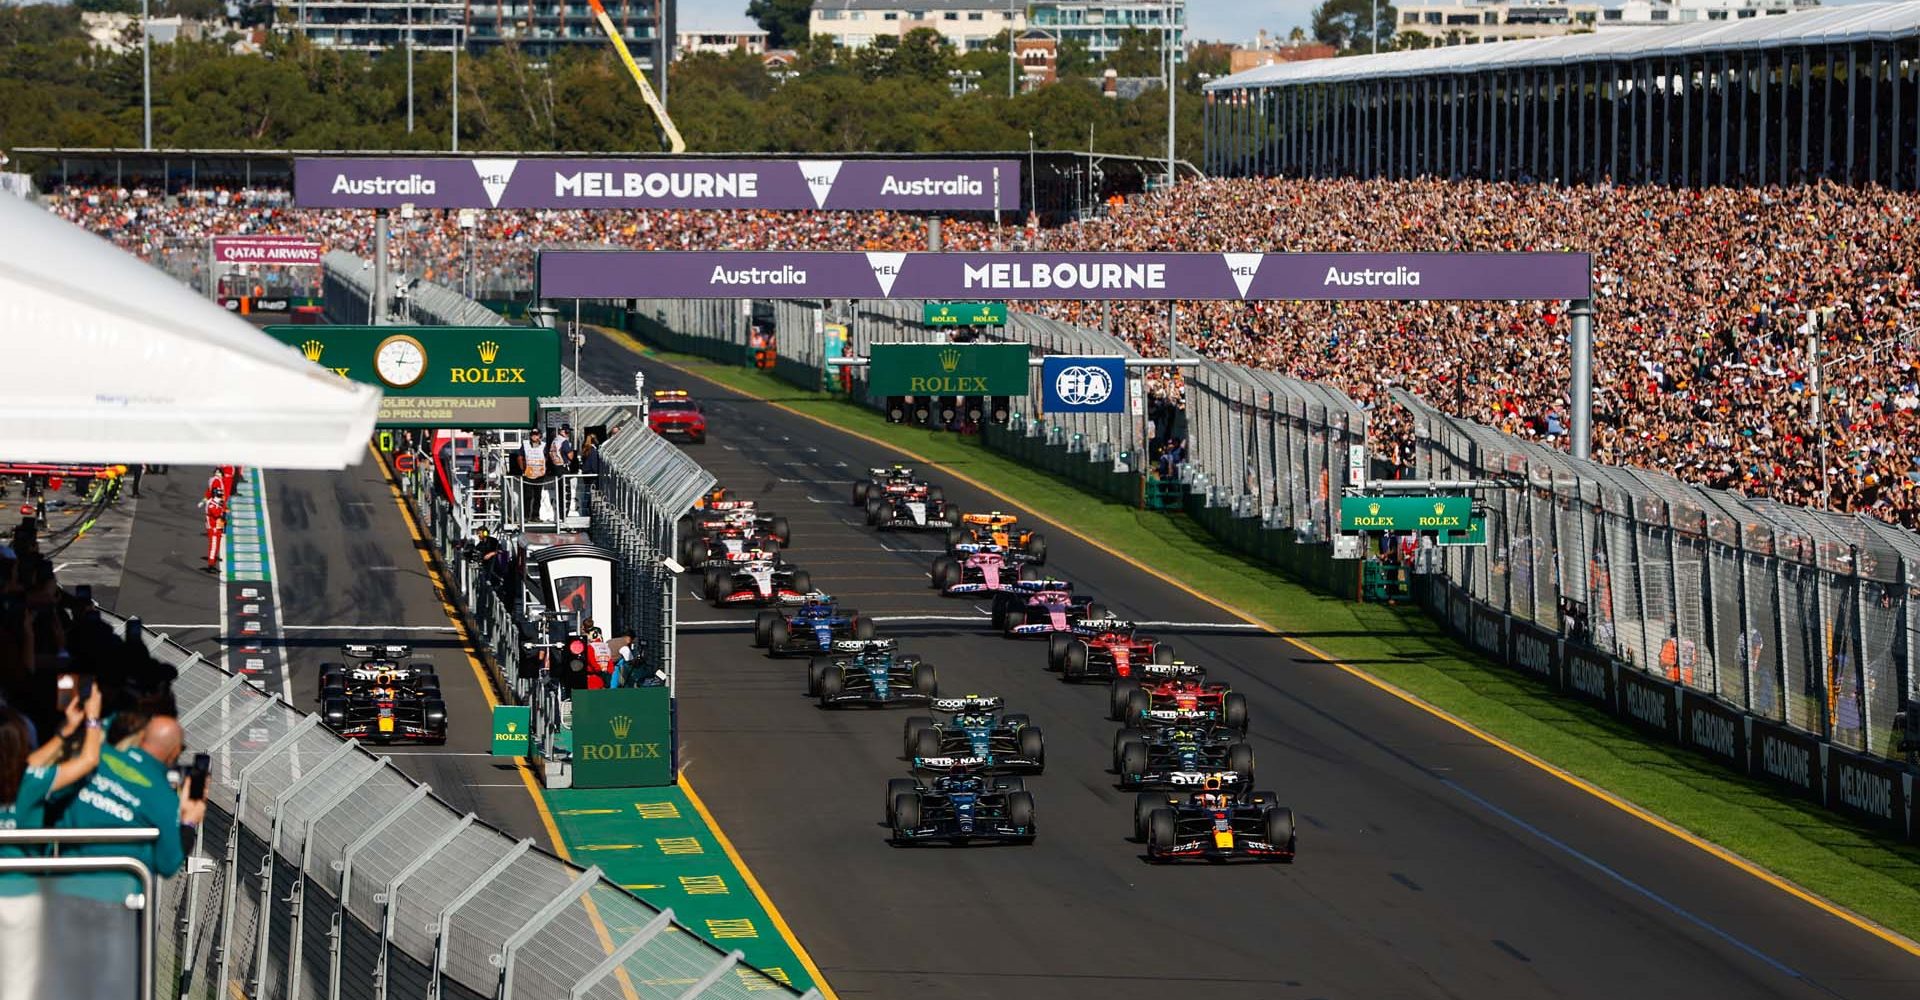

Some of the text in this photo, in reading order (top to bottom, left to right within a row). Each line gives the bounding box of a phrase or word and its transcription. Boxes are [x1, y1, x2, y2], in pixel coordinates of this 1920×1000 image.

[331, 174, 436, 195] Australia
[555, 171, 758, 198] MELBOURNE
[880, 175, 983, 195] Australia
[224, 247, 318, 259] QATAR AIRWAYS
[710, 265, 807, 285] Australia
[964, 262, 1166, 289] MELBOURNE
[1324, 266, 1420, 286] Australia
[450, 368, 526, 383] ROLEX
[911, 377, 989, 392] ROLEX
[417, 398, 496, 408] AUSTRALIAN
[393, 409, 421, 418] PRIX
[1354, 517, 1394, 526] ROLEX
[1419, 516, 1459, 526] ROLEX
[1626, 683, 1667, 729] MELBOURNE
[495, 733, 528, 741] ROLEX
[1691, 709, 1735, 758] MELBOURNE
[582, 743, 661, 760] ROLEX
[1763, 733, 1810, 788] MELBOURNE
[1839, 764, 1892, 819] MELBOURNE
